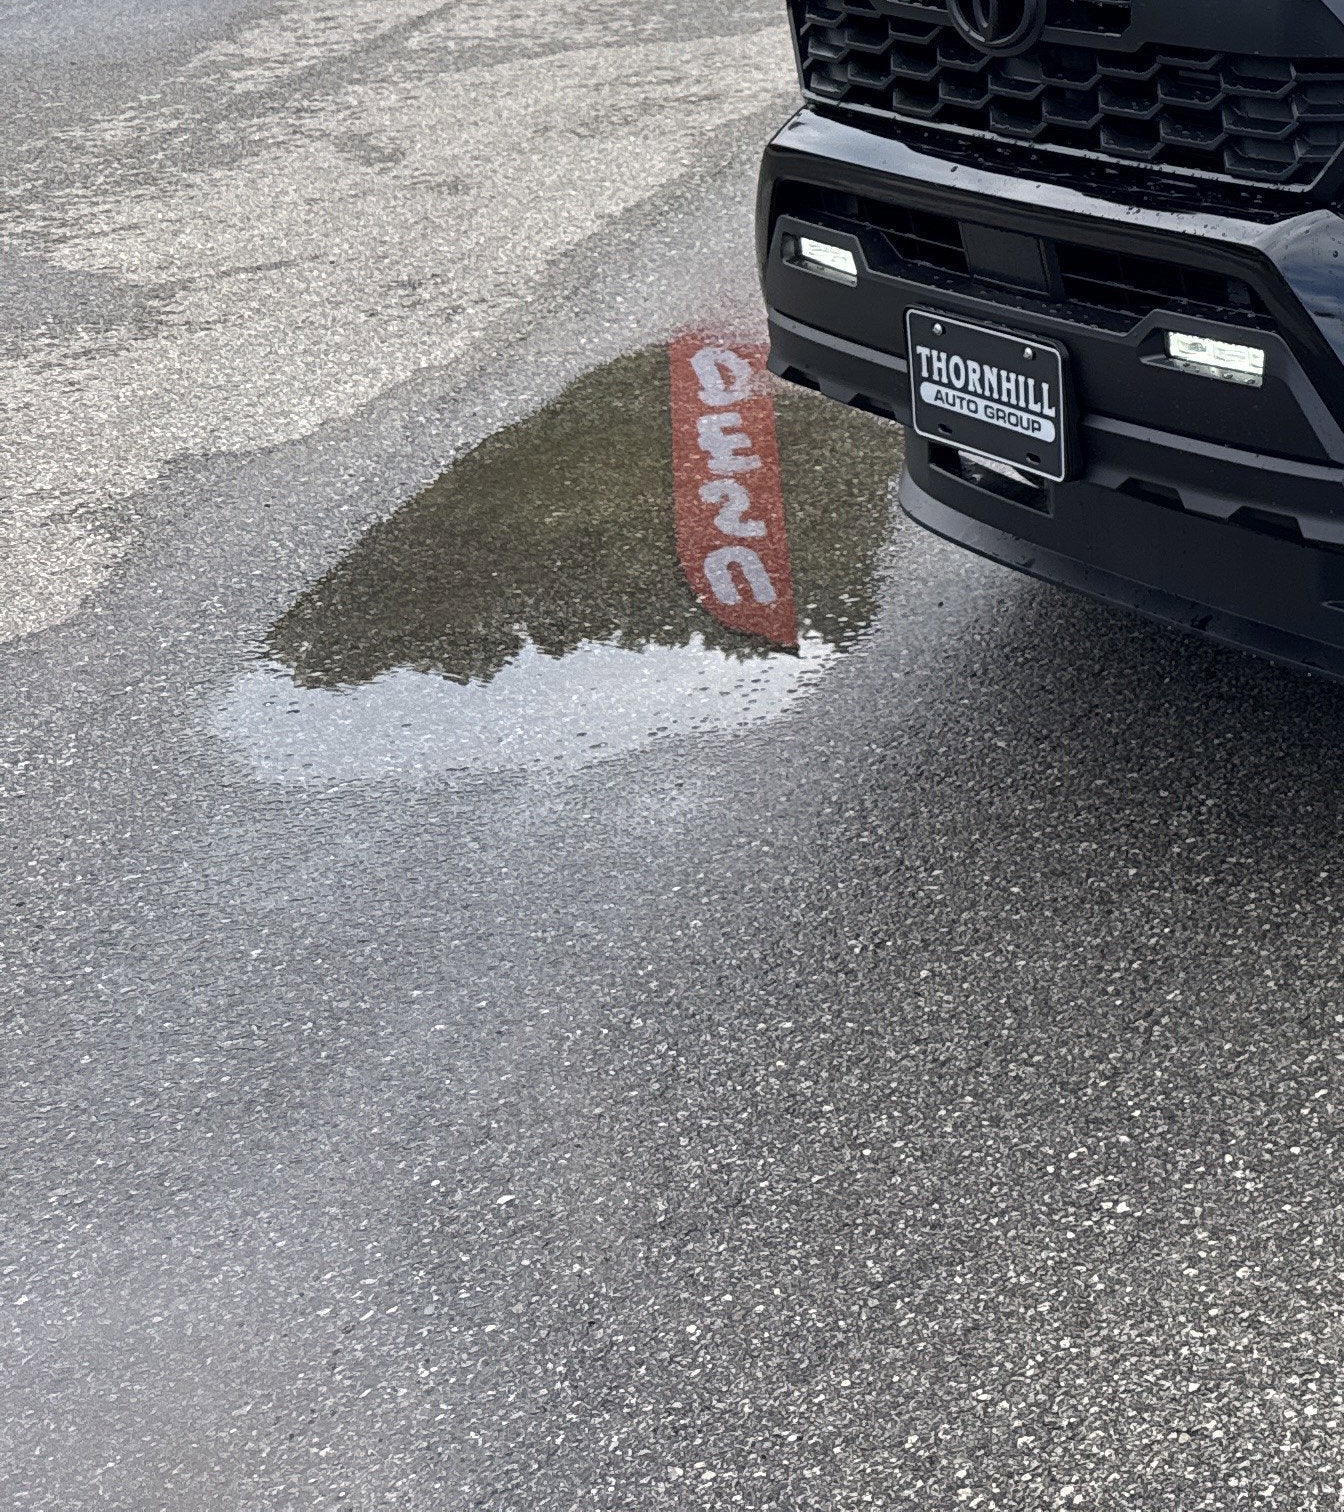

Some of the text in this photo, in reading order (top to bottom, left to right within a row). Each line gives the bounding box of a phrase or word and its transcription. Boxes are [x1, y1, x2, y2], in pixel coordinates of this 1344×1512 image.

[916, 345, 1056, 418] THORNHILL
[934, 389, 1042, 434] AUTO GROUP
